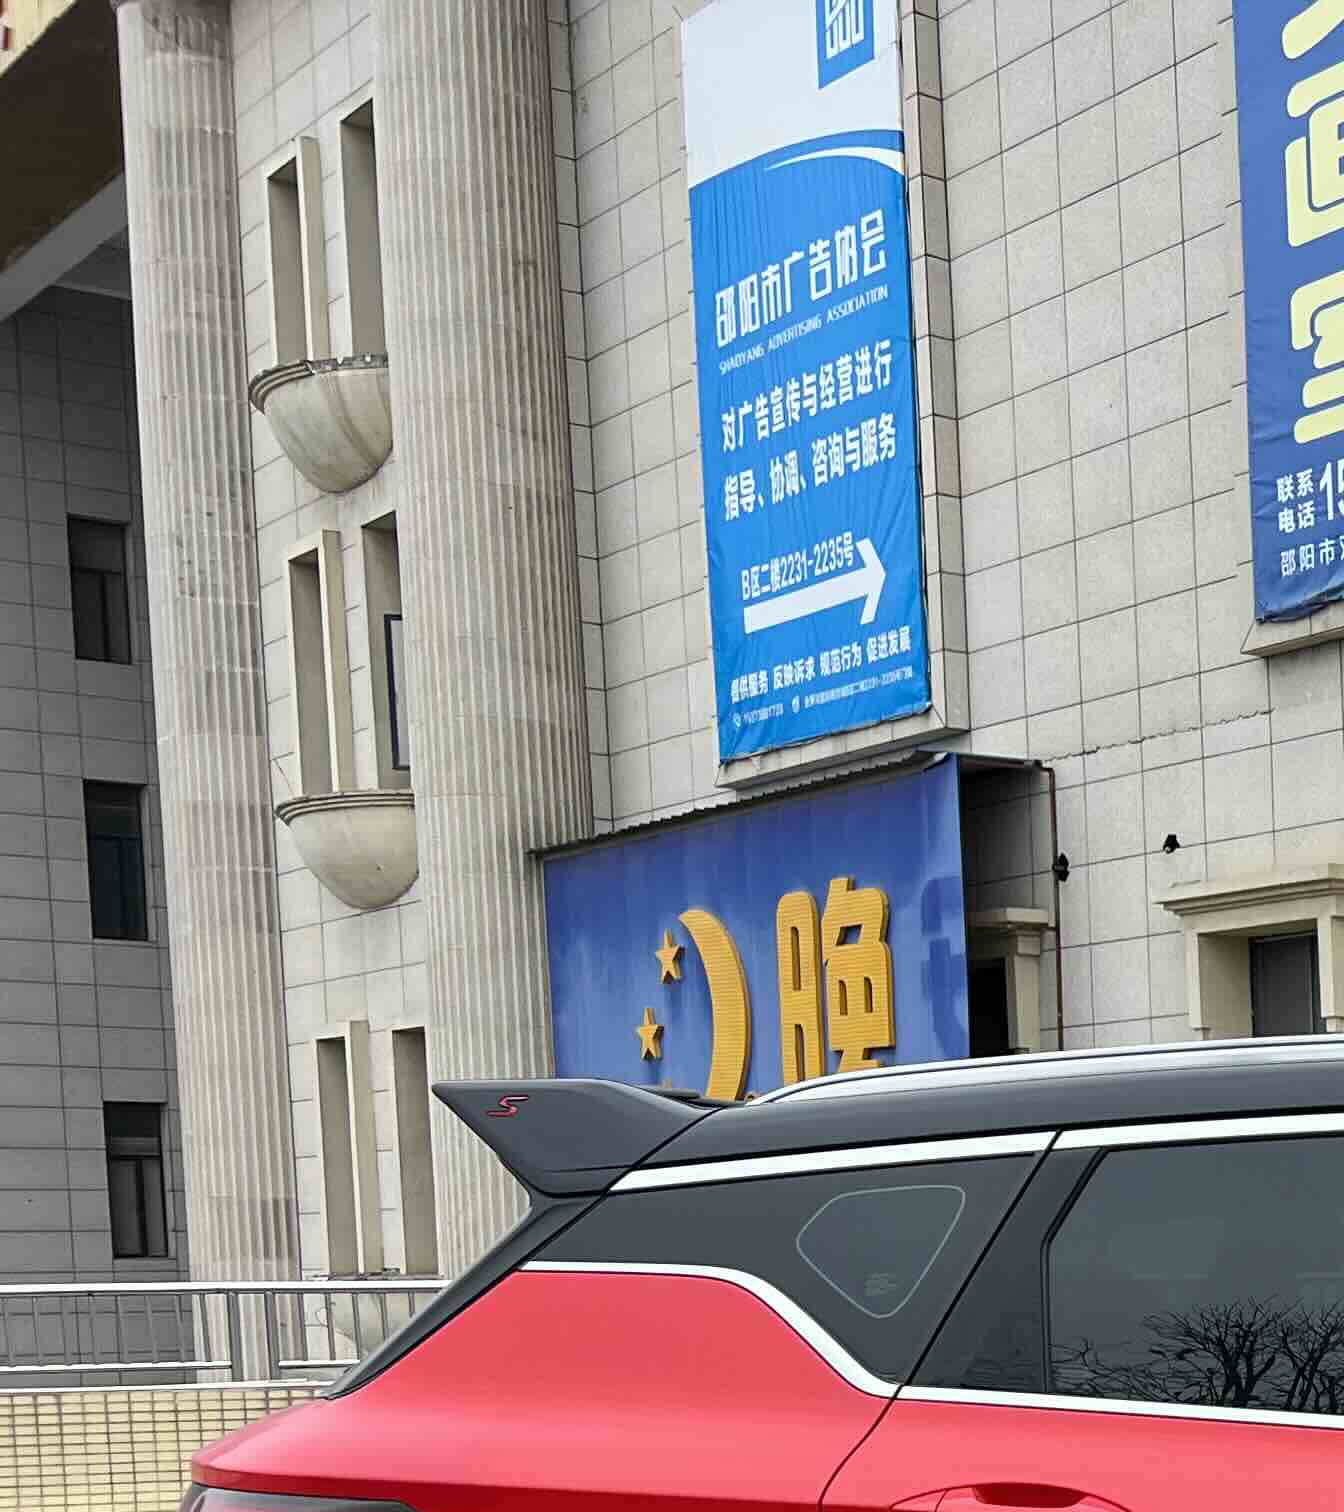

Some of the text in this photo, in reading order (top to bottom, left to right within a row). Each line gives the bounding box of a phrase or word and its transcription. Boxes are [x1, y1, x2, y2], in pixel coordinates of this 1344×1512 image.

[715, 208, 887, 349] 邵阳市广告协会
[721, 339, 893, 455] 对广告宣传与经营进行
[724, 412, 897, 521] 指导、协调、咨询与服务
[1276, 467, 1314, 503] 联系
[1278, 507, 1316, 534] 电话
[741, 531, 855, 601] B区二楼2231-2235号
